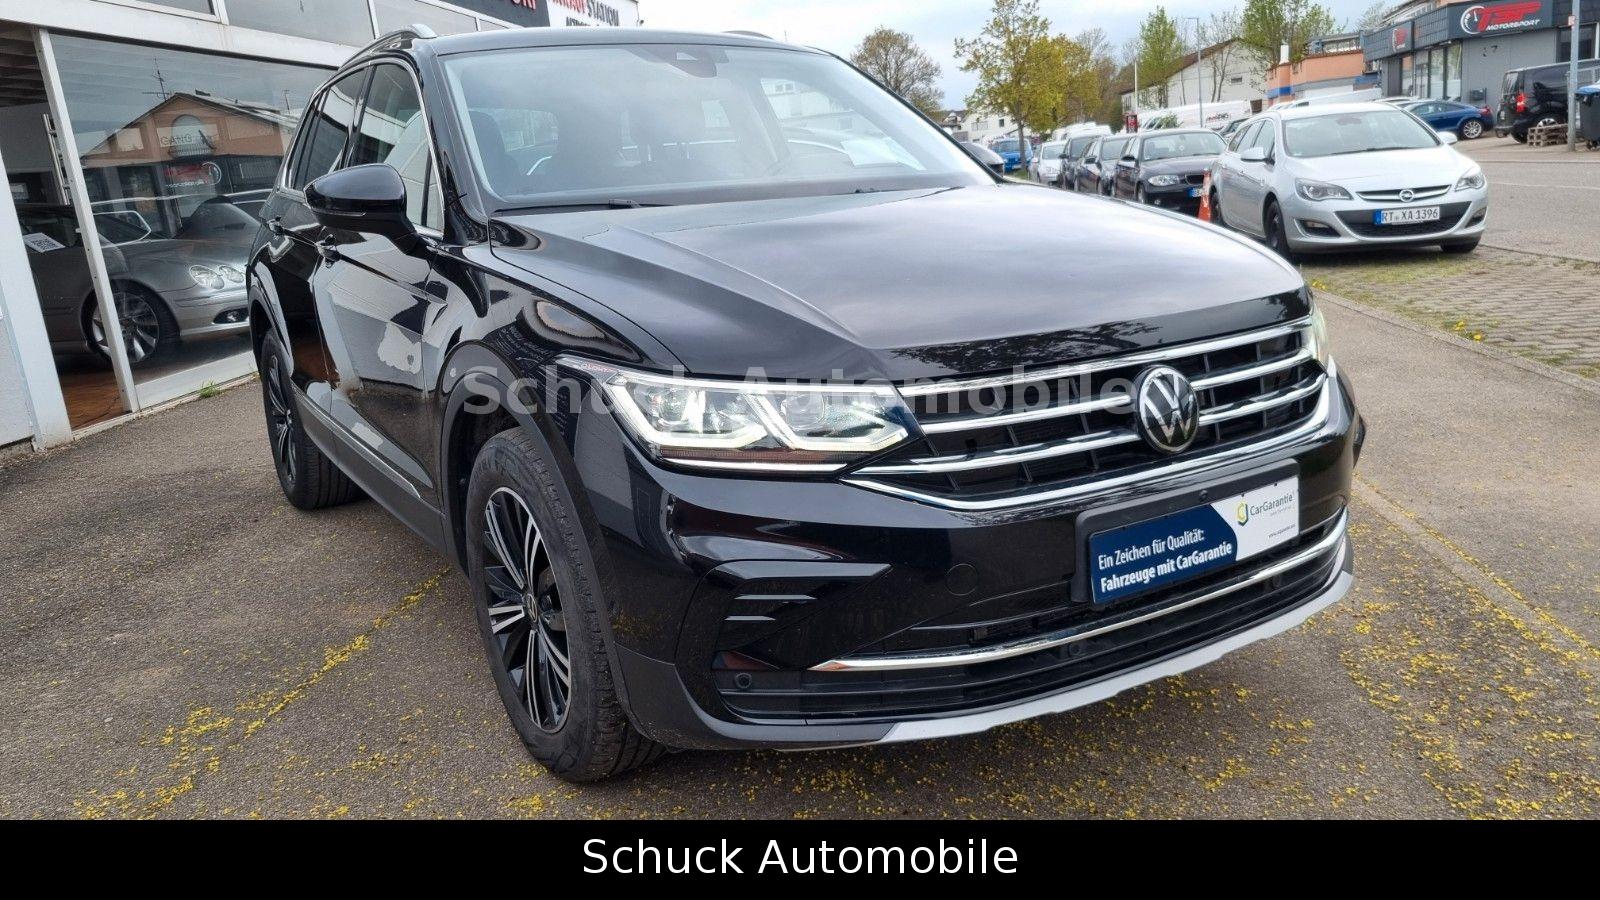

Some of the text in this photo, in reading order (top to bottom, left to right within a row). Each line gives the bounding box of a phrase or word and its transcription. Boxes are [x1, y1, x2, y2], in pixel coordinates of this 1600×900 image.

[1486, 19, 1540, 31] MOTORSPORT
[1401, 209, 1413, 220] XA
[1415, 208, 1439, 220] 1396
[1249, 493, 1293, 516] CarGarantie
[1098, 528, 1205, 570] Ein Zeichen für Qualität:
[1100, 541, 1232, 593] Fahrzeuge mit CarGarantie
